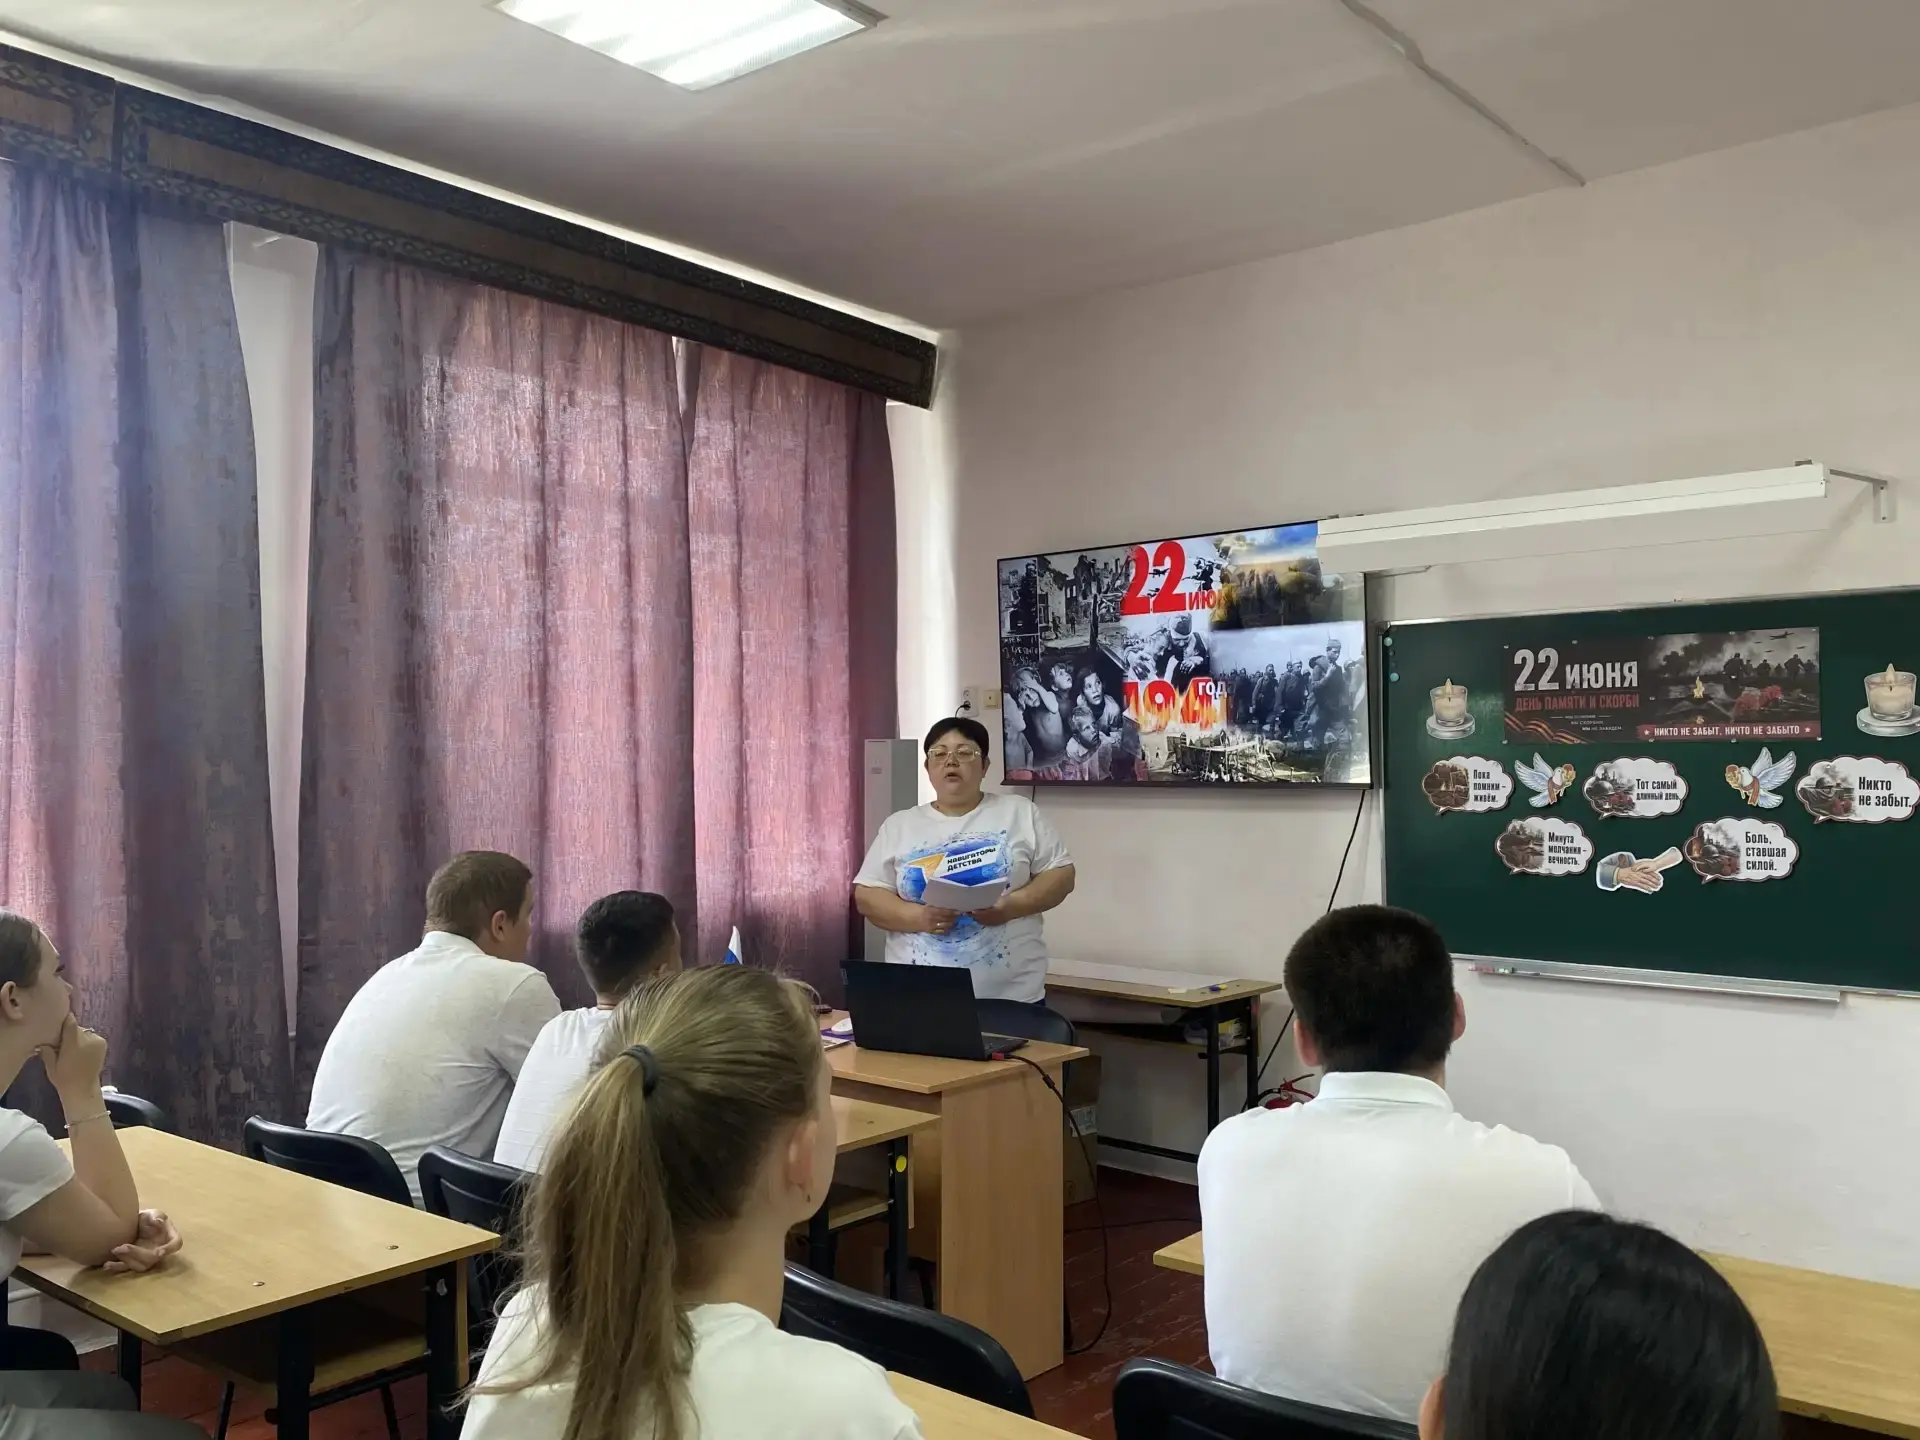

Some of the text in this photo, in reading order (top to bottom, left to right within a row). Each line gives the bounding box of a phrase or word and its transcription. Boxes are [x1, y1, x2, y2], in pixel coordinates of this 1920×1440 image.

[1120, 540, 1187, 616] 22
[1514, 647, 1559, 692] 22
[1515, 693, 1640, 712] ДЕНЬ ПАМЯТИ И СКОРБИ
[1654, 727, 1678, 736] НИКТО
[1680, 727, 1690, 736] НЕ
[1725, 726, 1750, 735] НИЧТО
[1753, 726, 1763, 735] НЕ
[1766, 725, 1800, 735] ЗАБЫТО
[1473, 769, 1491, 780] Пока
[1473, 782, 1500, 791] помним
[1636, 778, 1677, 790] Тот самый
[1858, 776, 1892, 791] Никто
[1858, 793, 1912, 808] не забыт.
[1548, 831, 1575, 846] Минута
[1745, 831, 1772, 845] Боль,
[947, 847, 996, 865] НАВИГАТОРЫ
[1745, 847, 1787, 858] ставшая
[947, 857, 982, 872] ДЕТСТВА
[1548, 855, 1580, 866] вечность.
[1746, 859, 1778, 871] силой.
